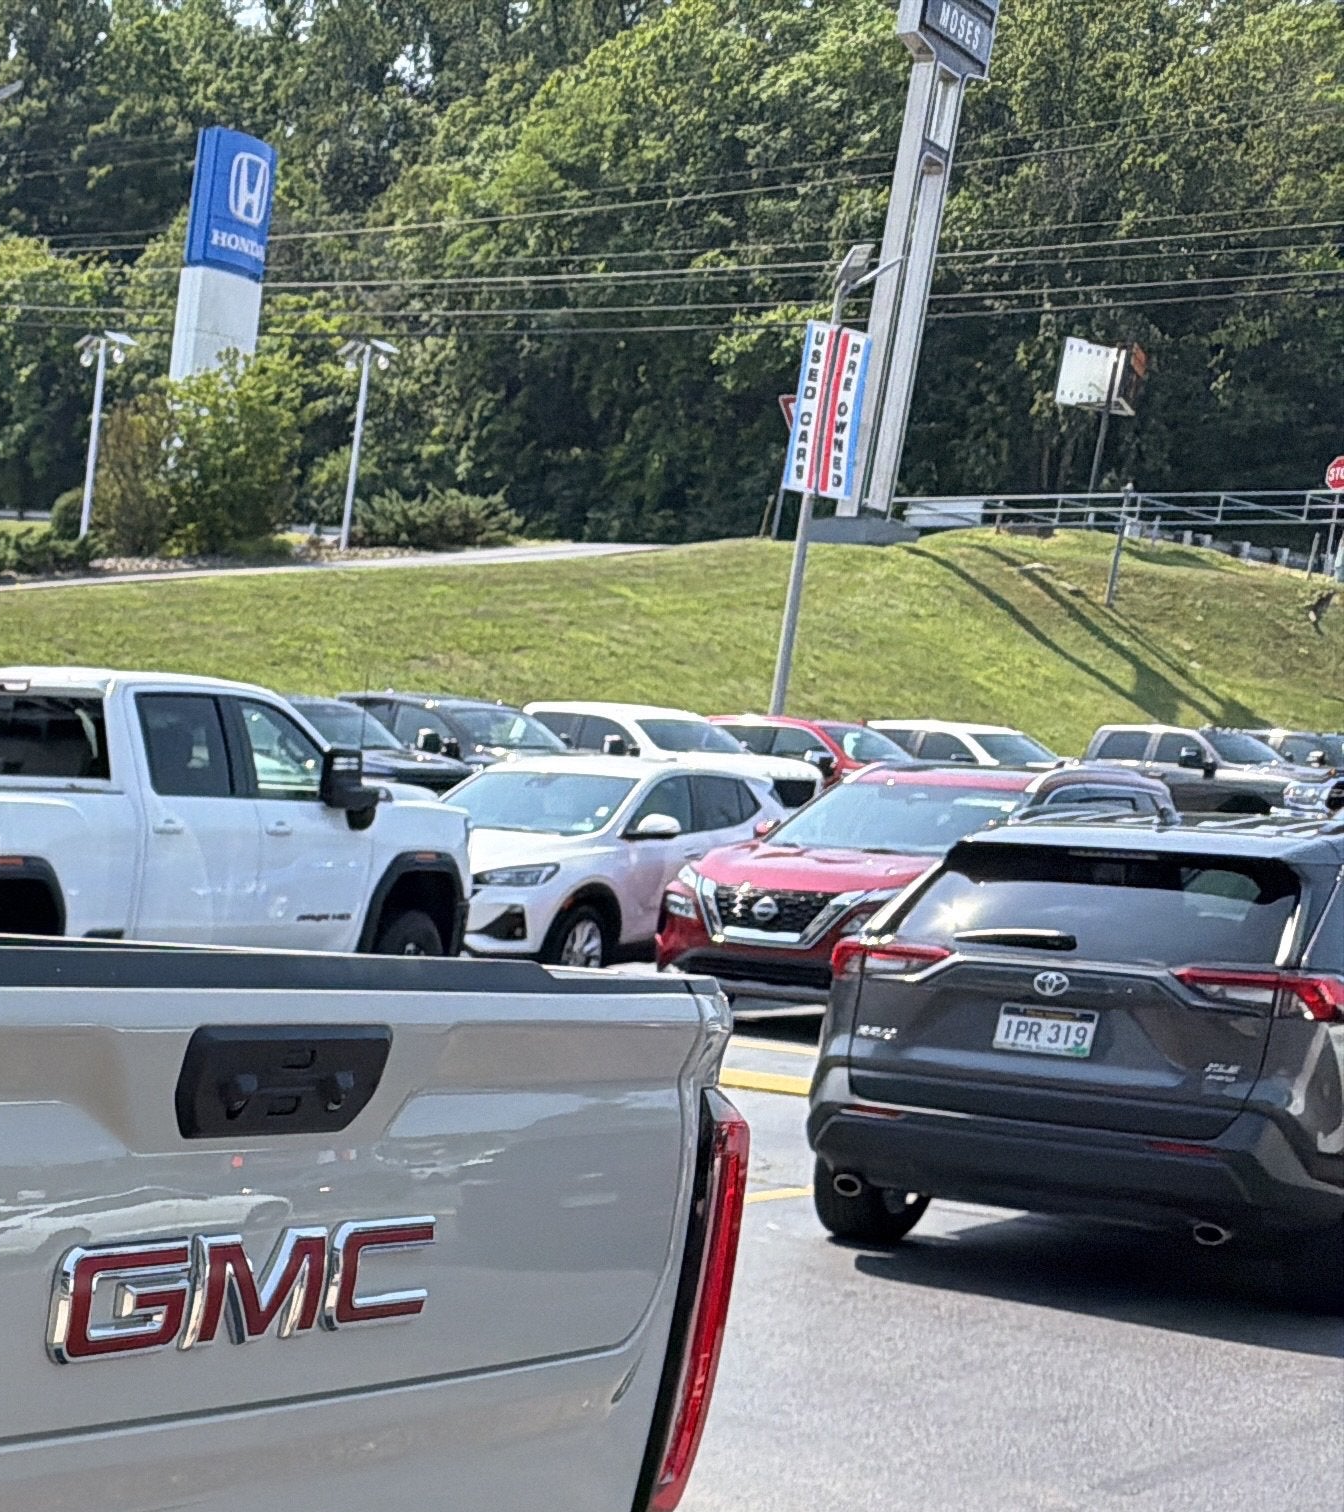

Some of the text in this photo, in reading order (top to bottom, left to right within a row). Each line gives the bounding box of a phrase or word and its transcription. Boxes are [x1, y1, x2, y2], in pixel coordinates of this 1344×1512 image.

[939, 1, 981, 50] MOSES
[211, 228, 265, 263] HONDA
[796, 331, 825, 480] USED CARS
[831, 343, 861, 487] PRE OWNED
[1004, 1020, 1042, 1043] 1PR
[1047, 1023, 1088, 1047] 319
[46, 1215, 437, 1364] GMC
